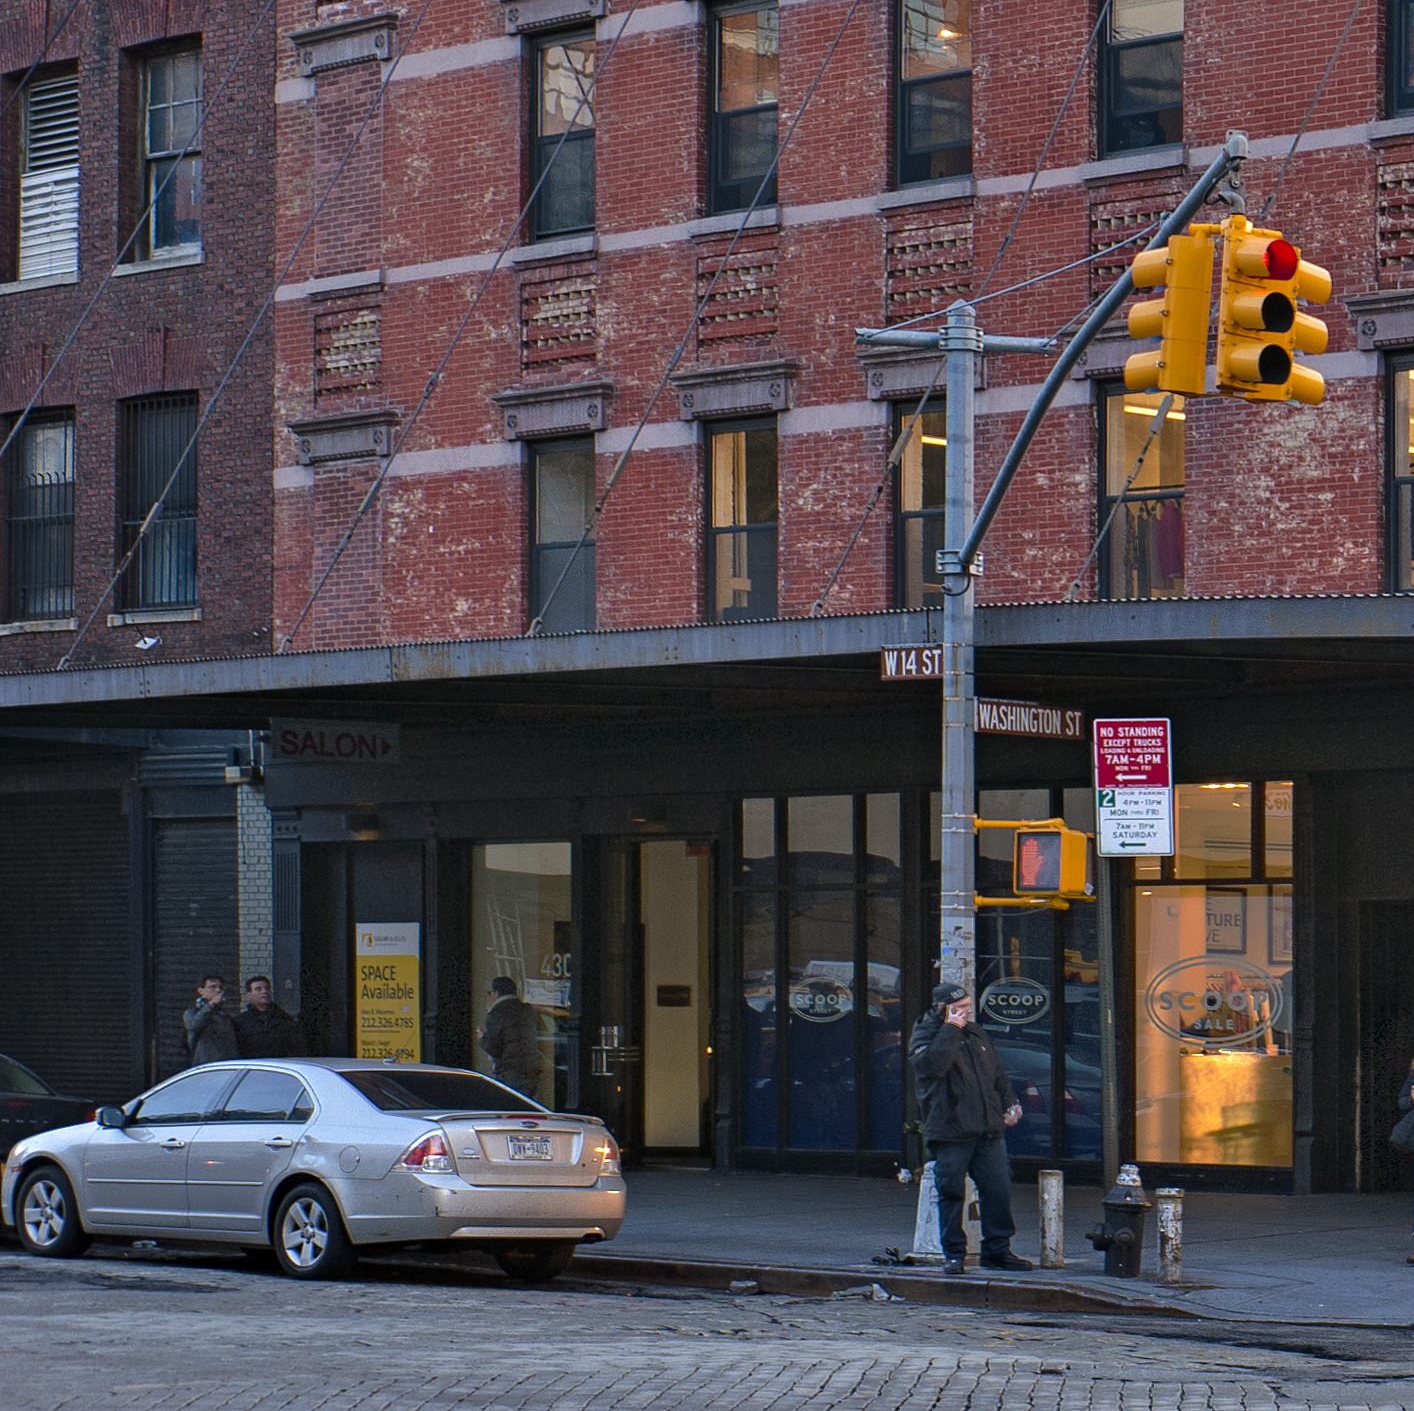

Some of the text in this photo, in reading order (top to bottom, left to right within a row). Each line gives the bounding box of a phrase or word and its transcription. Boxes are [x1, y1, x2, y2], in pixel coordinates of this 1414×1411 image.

[885, 649, 942, 676] W 14 ST
[979, 704, 1082, 736] WASHINGTON ST
[1100, 726, 1164, 737] NO STANDING
[281, 730, 377, 758] SALON
[1103, 738, 1161, 747] EXCEPT TRUCKS
[1105, 754, 1161, 764] 7AM-4PM
[1102, 790, 1113, 807] 2
[361, 966, 396, 981] SPACE
[361, 983, 414, 1000] Available
[796, 994, 845, 1005] SCOOP
[988, 994, 1043, 1006] SCOOP
[1159, 991, 1267, 1011] SCOOP
[1194, 1018, 1234, 1030] SALE
